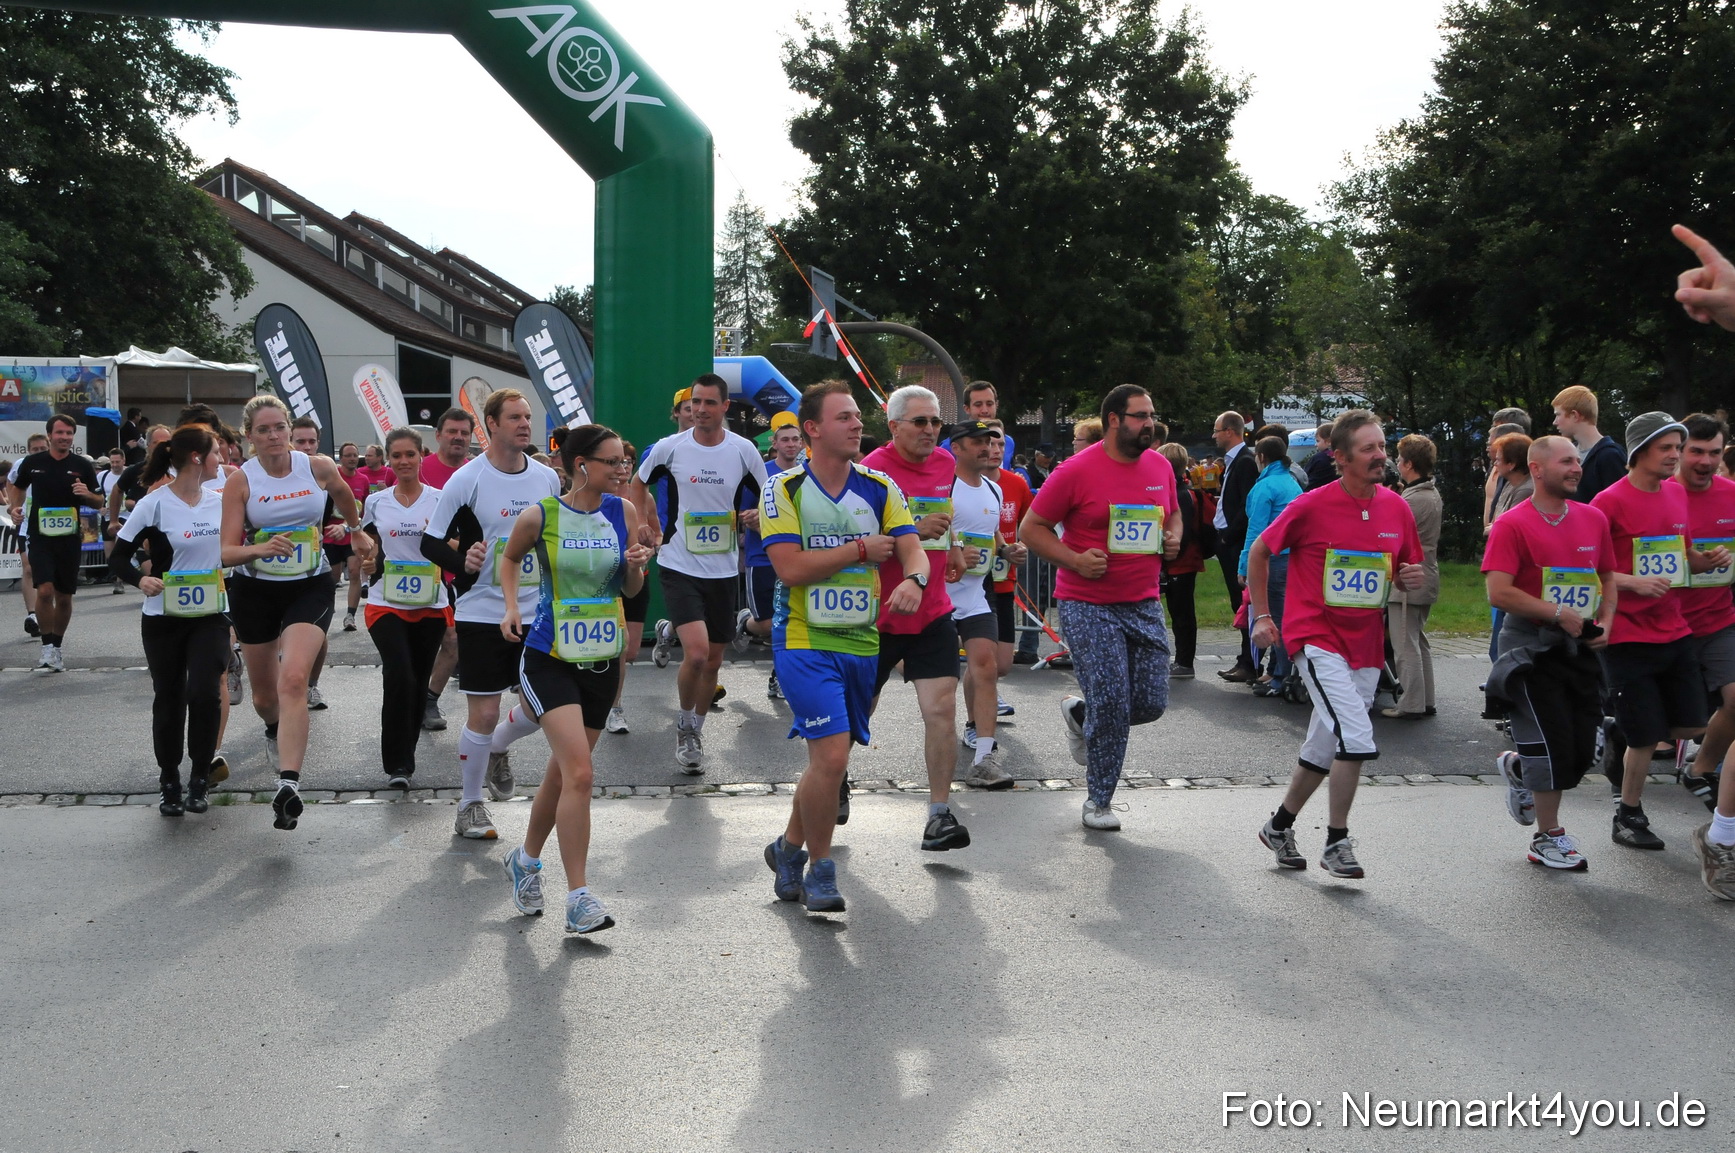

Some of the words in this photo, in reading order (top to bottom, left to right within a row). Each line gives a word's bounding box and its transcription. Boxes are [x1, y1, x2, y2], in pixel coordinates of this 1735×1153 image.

[488, 5, 666, 152] AOK
[28, 389, 91, 407] Logistics
[697, 477, 724, 485] UniCredit
[273, 490, 314, 501] KLEBL
[41, 518, 72, 528] 1352
[810, 523, 848, 533] TEAM
[1114, 521, 1153, 541] 357
[563, 539, 613, 549] BOCK
[696, 526, 720, 543] 46
[1639, 553, 1677, 575] 333
[396, 576, 422, 594] 49
[1331, 569, 1378, 594] 346
[178, 586, 205, 606] 50
[810, 588, 869, 612] 1063
[1549, 586, 1590, 608] 345
[559, 620, 616, 644] 1049
